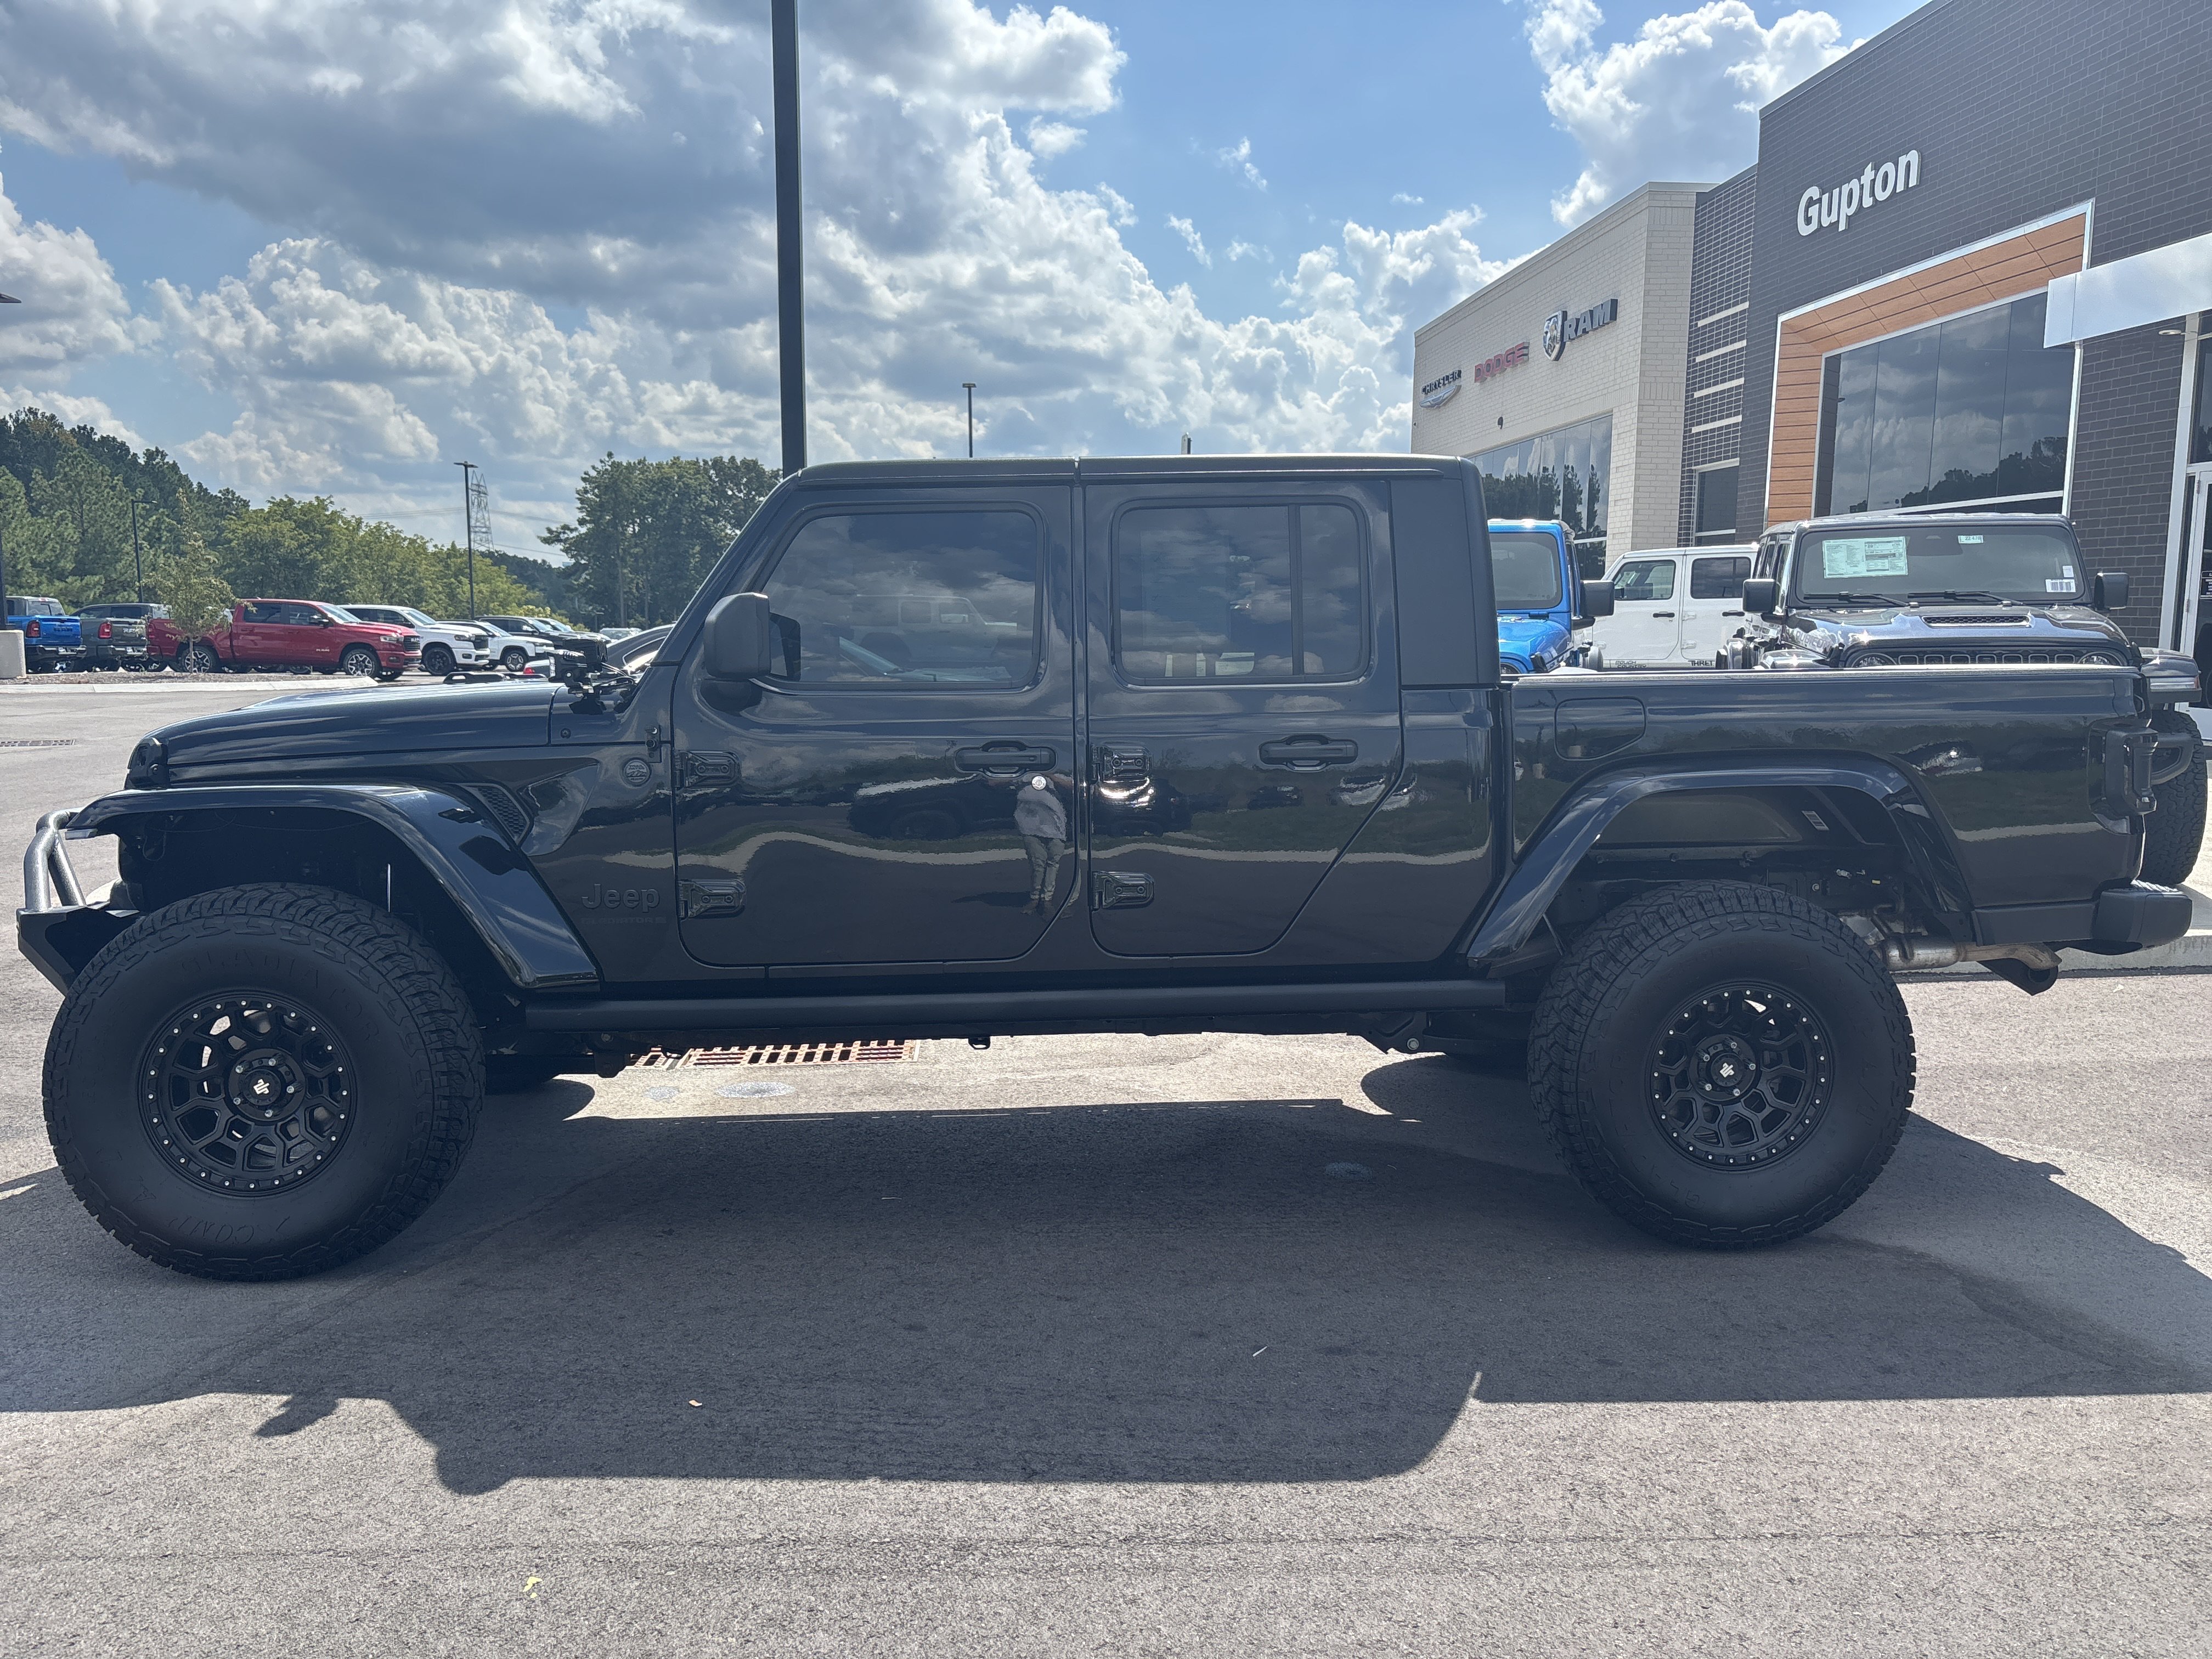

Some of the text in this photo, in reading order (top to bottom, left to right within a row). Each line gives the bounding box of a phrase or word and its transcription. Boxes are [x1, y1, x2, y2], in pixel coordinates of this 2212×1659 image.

[1797, 149, 1921, 236] Gupton
[1564, 298, 1618, 342] RAM
[1421, 369, 1462, 395] CHRYSLER
[1474, 341, 1530, 383] DODGE
[581, 883, 660, 913] Jeep
